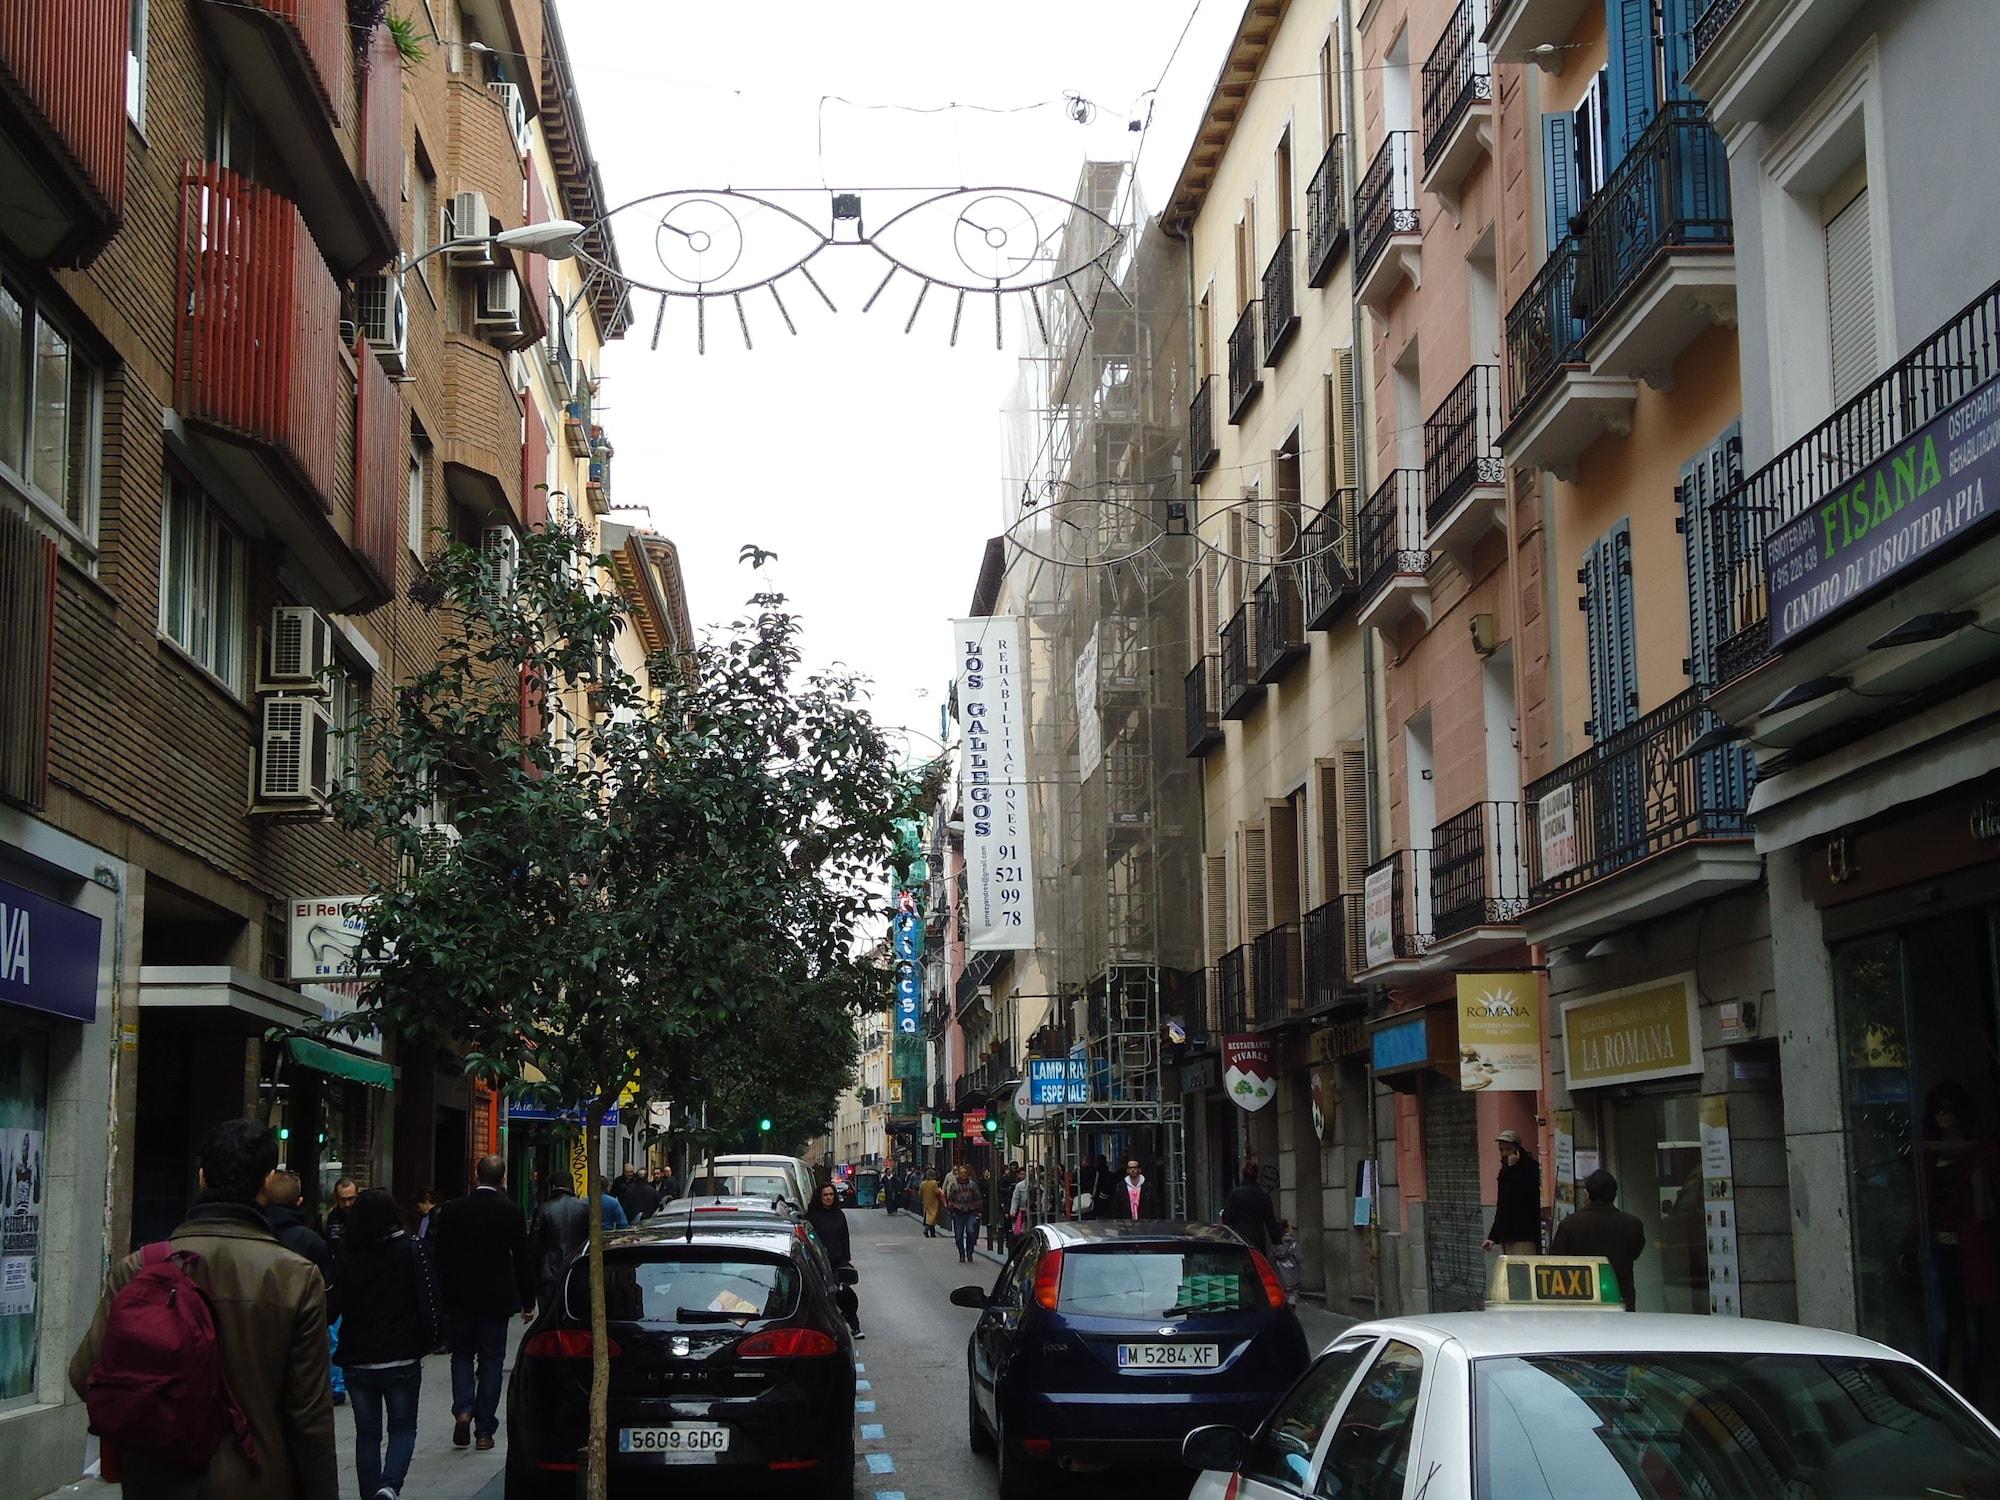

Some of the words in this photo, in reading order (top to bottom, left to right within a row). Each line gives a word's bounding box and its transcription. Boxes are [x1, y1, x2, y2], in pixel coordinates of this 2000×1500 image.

[1820, 433, 1943, 560] FISANA
[1767, 516, 1816, 566] FISIOTERAPIA
[1783, 573, 1840, 634] CENTRO
[1844, 562, 1864, 598] DE
[1867, 477, 1985, 580] FISIOTERAPIA
[964, 641, 984, 691] LOS
[997, 640, 1017, 836] REHABILITACIONES
[966, 703, 992, 837] GALLEGOS
[999, 844, 1018, 861] 91
[995, 867, 1023, 883] 521
[1001, 889, 1021, 906] 99
[1002, 911, 1022, 928] 78
[316, 965, 330, 974] EN
[1466, 1006, 1530, 1018] ROMANA
[1228, 1041, 1271, 1050] RESTAURANTE
[1582, 1040, 1599, 1071] LA
[1605, 1024, 1674, 1067] ROMANA
[1032, 1061, 1087, 1079] LAMPARA
[1041, 1084, 1088, 1103] ESPECIALE
[1537, 1270, 1592, 1296] TAXI
[1128, 1347, 1138, 1363] M
[632, 1431, 680, 1448] 5609
[687, 1431, 723, 1448] GDG
